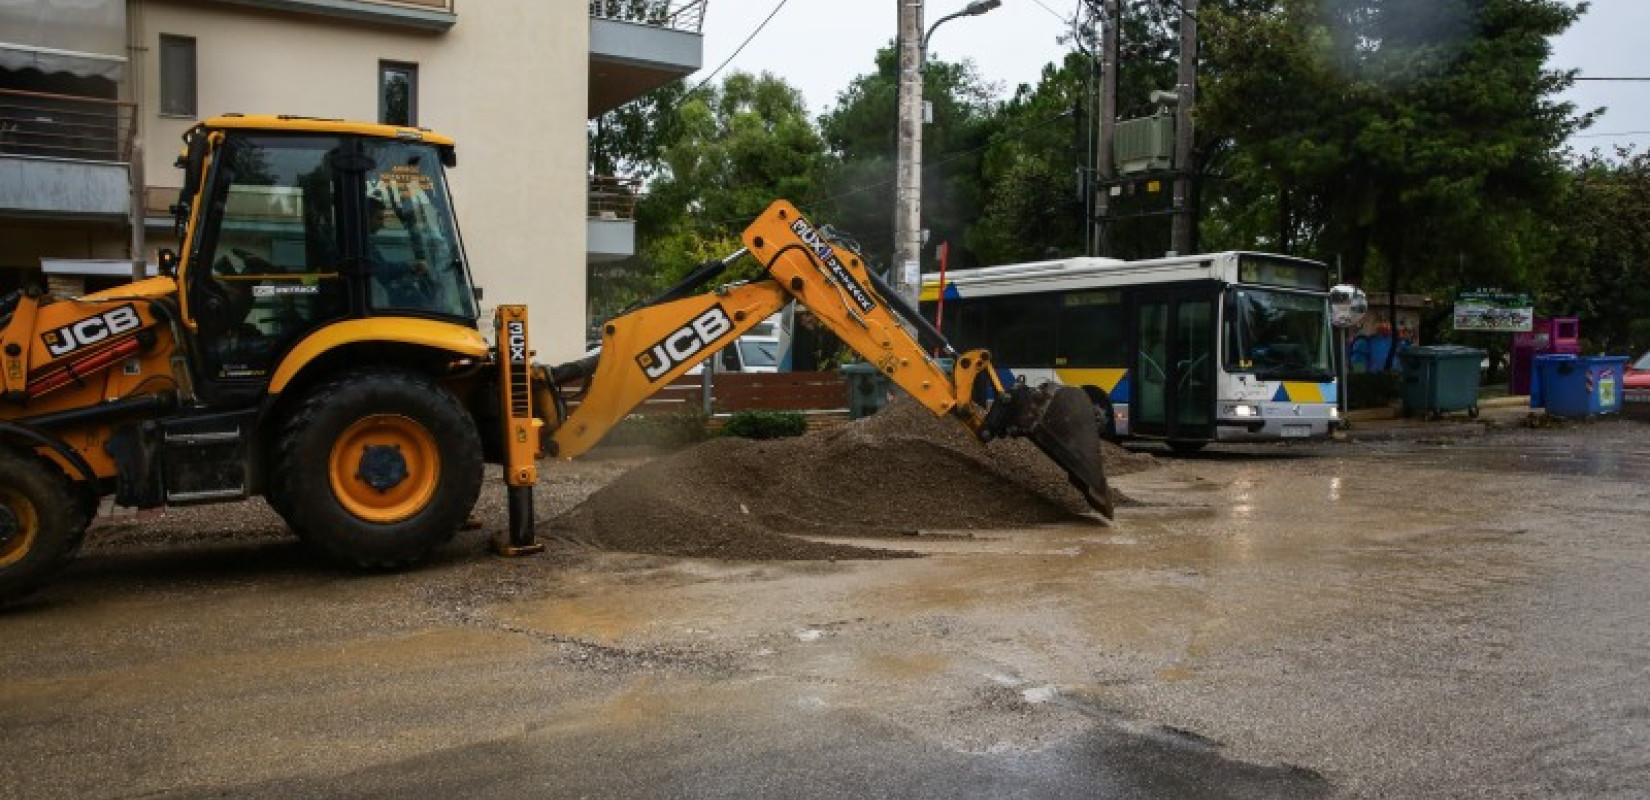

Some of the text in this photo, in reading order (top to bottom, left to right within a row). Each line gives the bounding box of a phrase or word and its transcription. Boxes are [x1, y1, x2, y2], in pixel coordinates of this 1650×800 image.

[50, 306, 139, 355] JCB
[509, 322, 524, 361] 3CX
[646, 308, 731, 378] JCB
